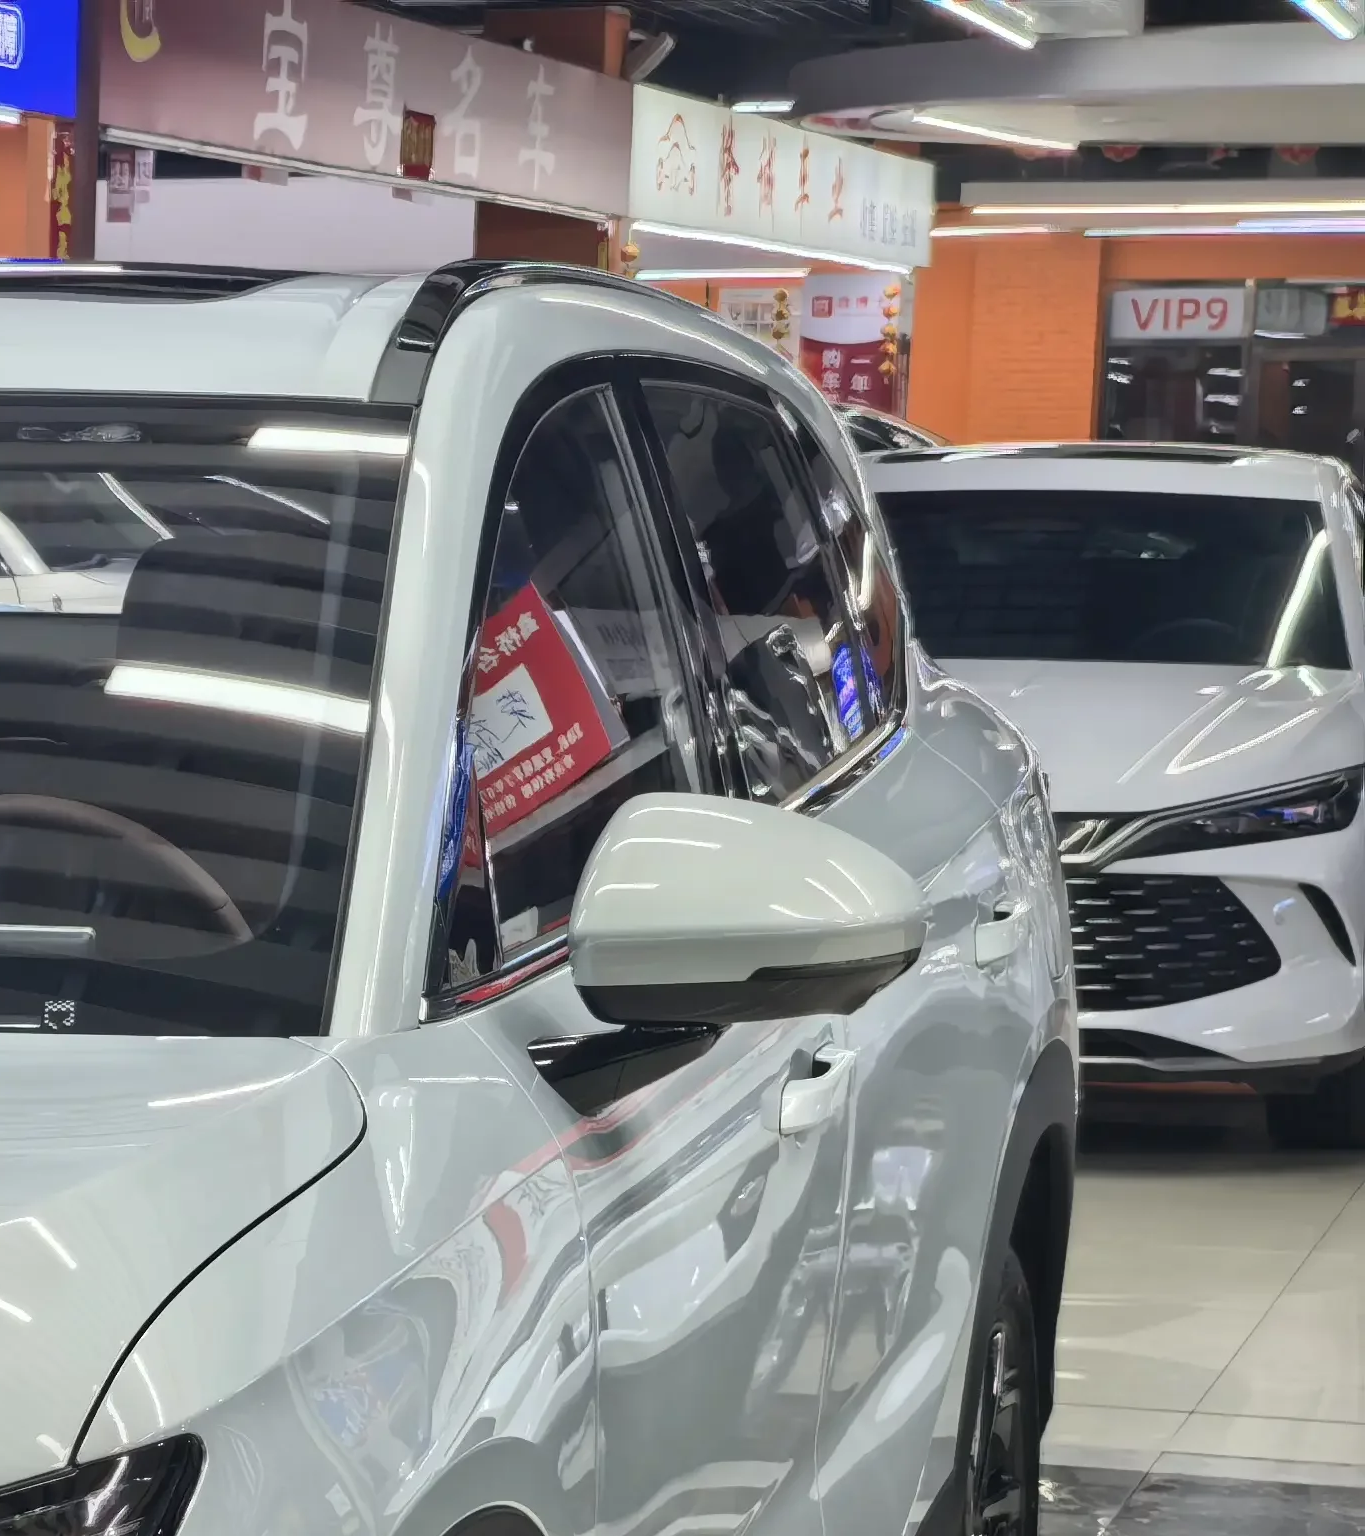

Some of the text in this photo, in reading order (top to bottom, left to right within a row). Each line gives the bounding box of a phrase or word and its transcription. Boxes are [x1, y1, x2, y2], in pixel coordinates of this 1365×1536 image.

[253, 0, 556, 191] 宝尊名车
[1130, 297, 1229, 332] VIP9
